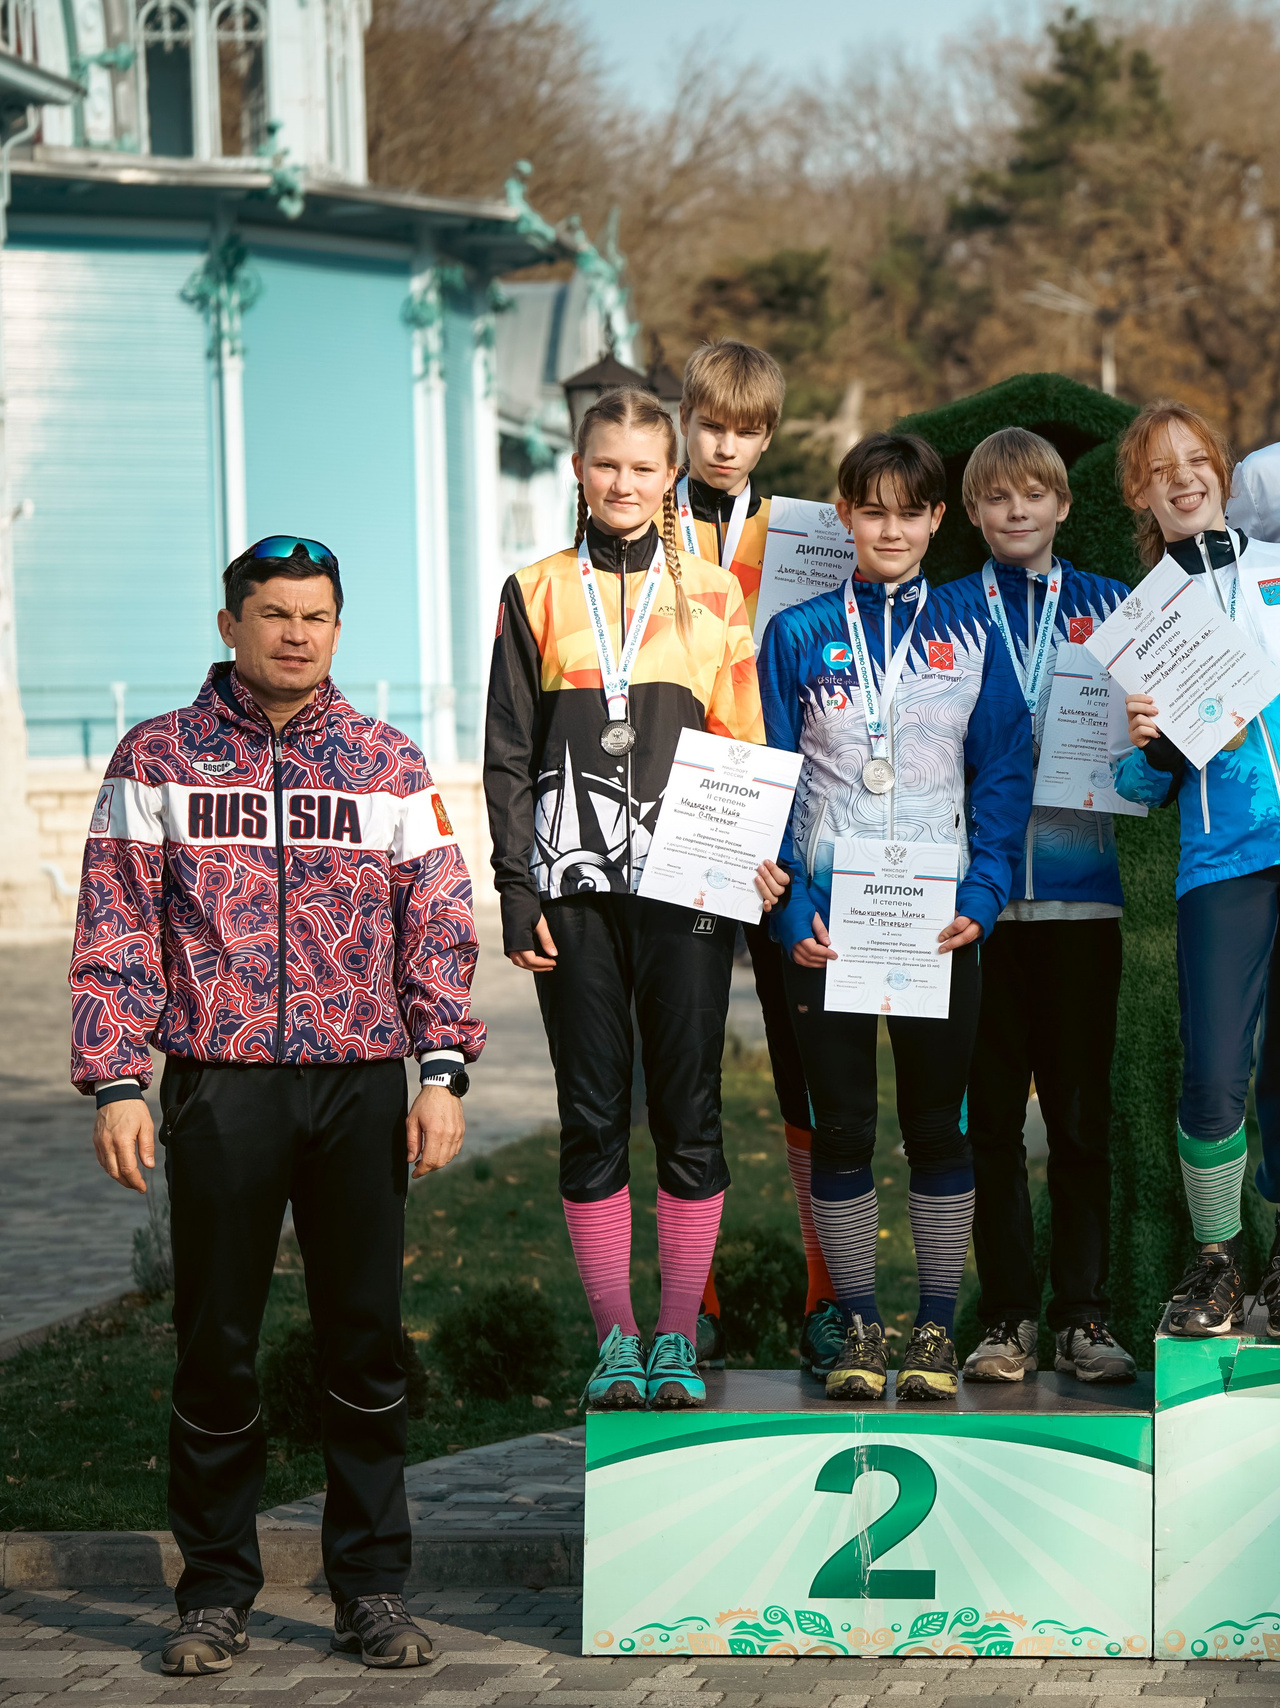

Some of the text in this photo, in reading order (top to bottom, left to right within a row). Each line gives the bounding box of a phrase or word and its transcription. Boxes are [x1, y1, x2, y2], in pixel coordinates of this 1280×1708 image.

[796, 544, 854, 560] ДИПЛОМ
[810, 561, 842, 569] степень
[587, 582, 612, 675] МИНИСТЕРСТВО СПОРТА РОССИИ
[1134, 609, 1154, 631] МИНСПОРТ
[1139, 616, 1155, 632] РОССИИ
[1133, 609, 1182, 660] ДИПЛОМ
[1154, 628, 1181, 656] степень
[1030, 600, 1053, 693] МИНИСТЕРСТВО СПОРТА РОССИИ
[621, 646, 633, 672] РОССИИ
[851, 621, 874, 715] МИНИСТЕРСТВО СПОРТА РОССИИ
[1144, 677, 1162, 695] Команда
[204, 763, 225, 772] BOSCO
[721, 764, 748, 774] МИНСПОРТ
[723, 770, 743, 778] РОССИИ
[699, 777, 760, 801] ДИПЛОМ
[713, 795, 746, 808] степень
[673, 808, 695, 817] Команда
[863, 884, 923, 898] ДИПЛОМ
[901, 909, 925, 918] Мария
[809, 1444, 938, 1600] 2
